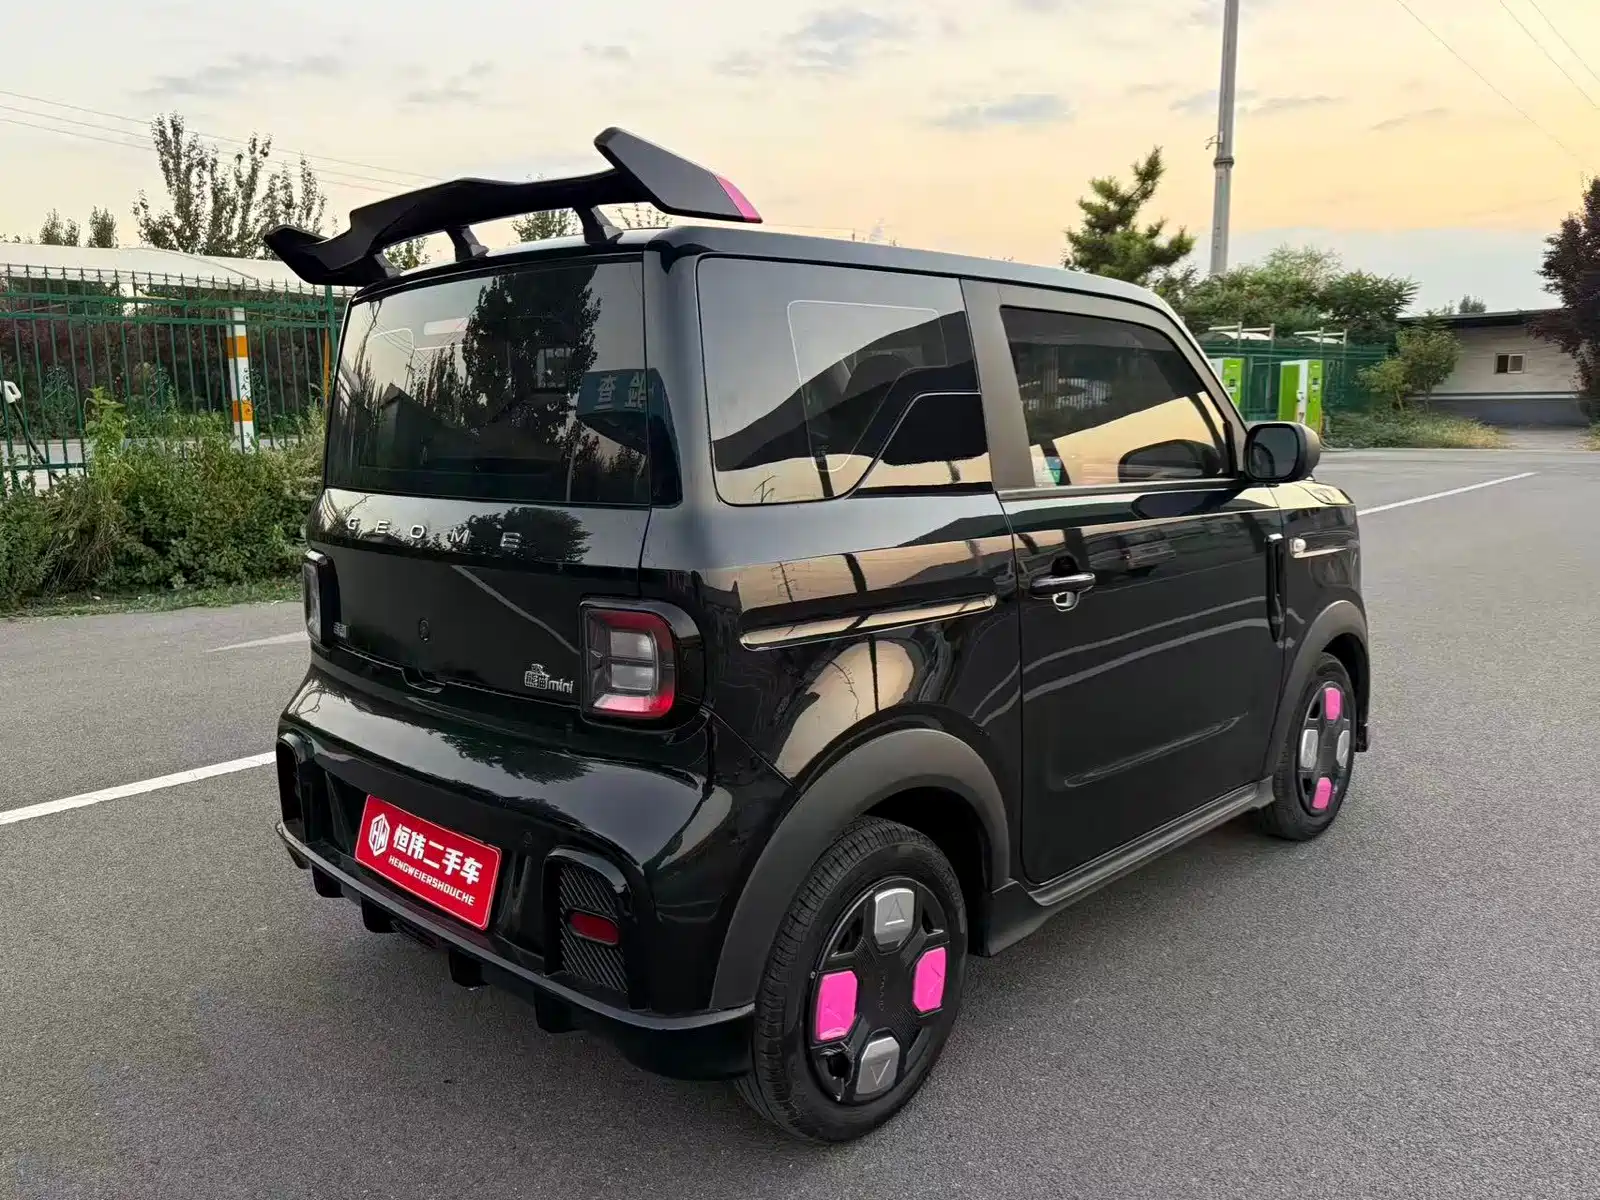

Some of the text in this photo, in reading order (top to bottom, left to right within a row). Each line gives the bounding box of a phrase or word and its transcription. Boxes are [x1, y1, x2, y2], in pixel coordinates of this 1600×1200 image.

[346, 516, 522, 549] GEOME
[393, 823, 483, 885] 恒伟二手车
[388, 855, 476, 906] HENGWEIERSHOUCHE
